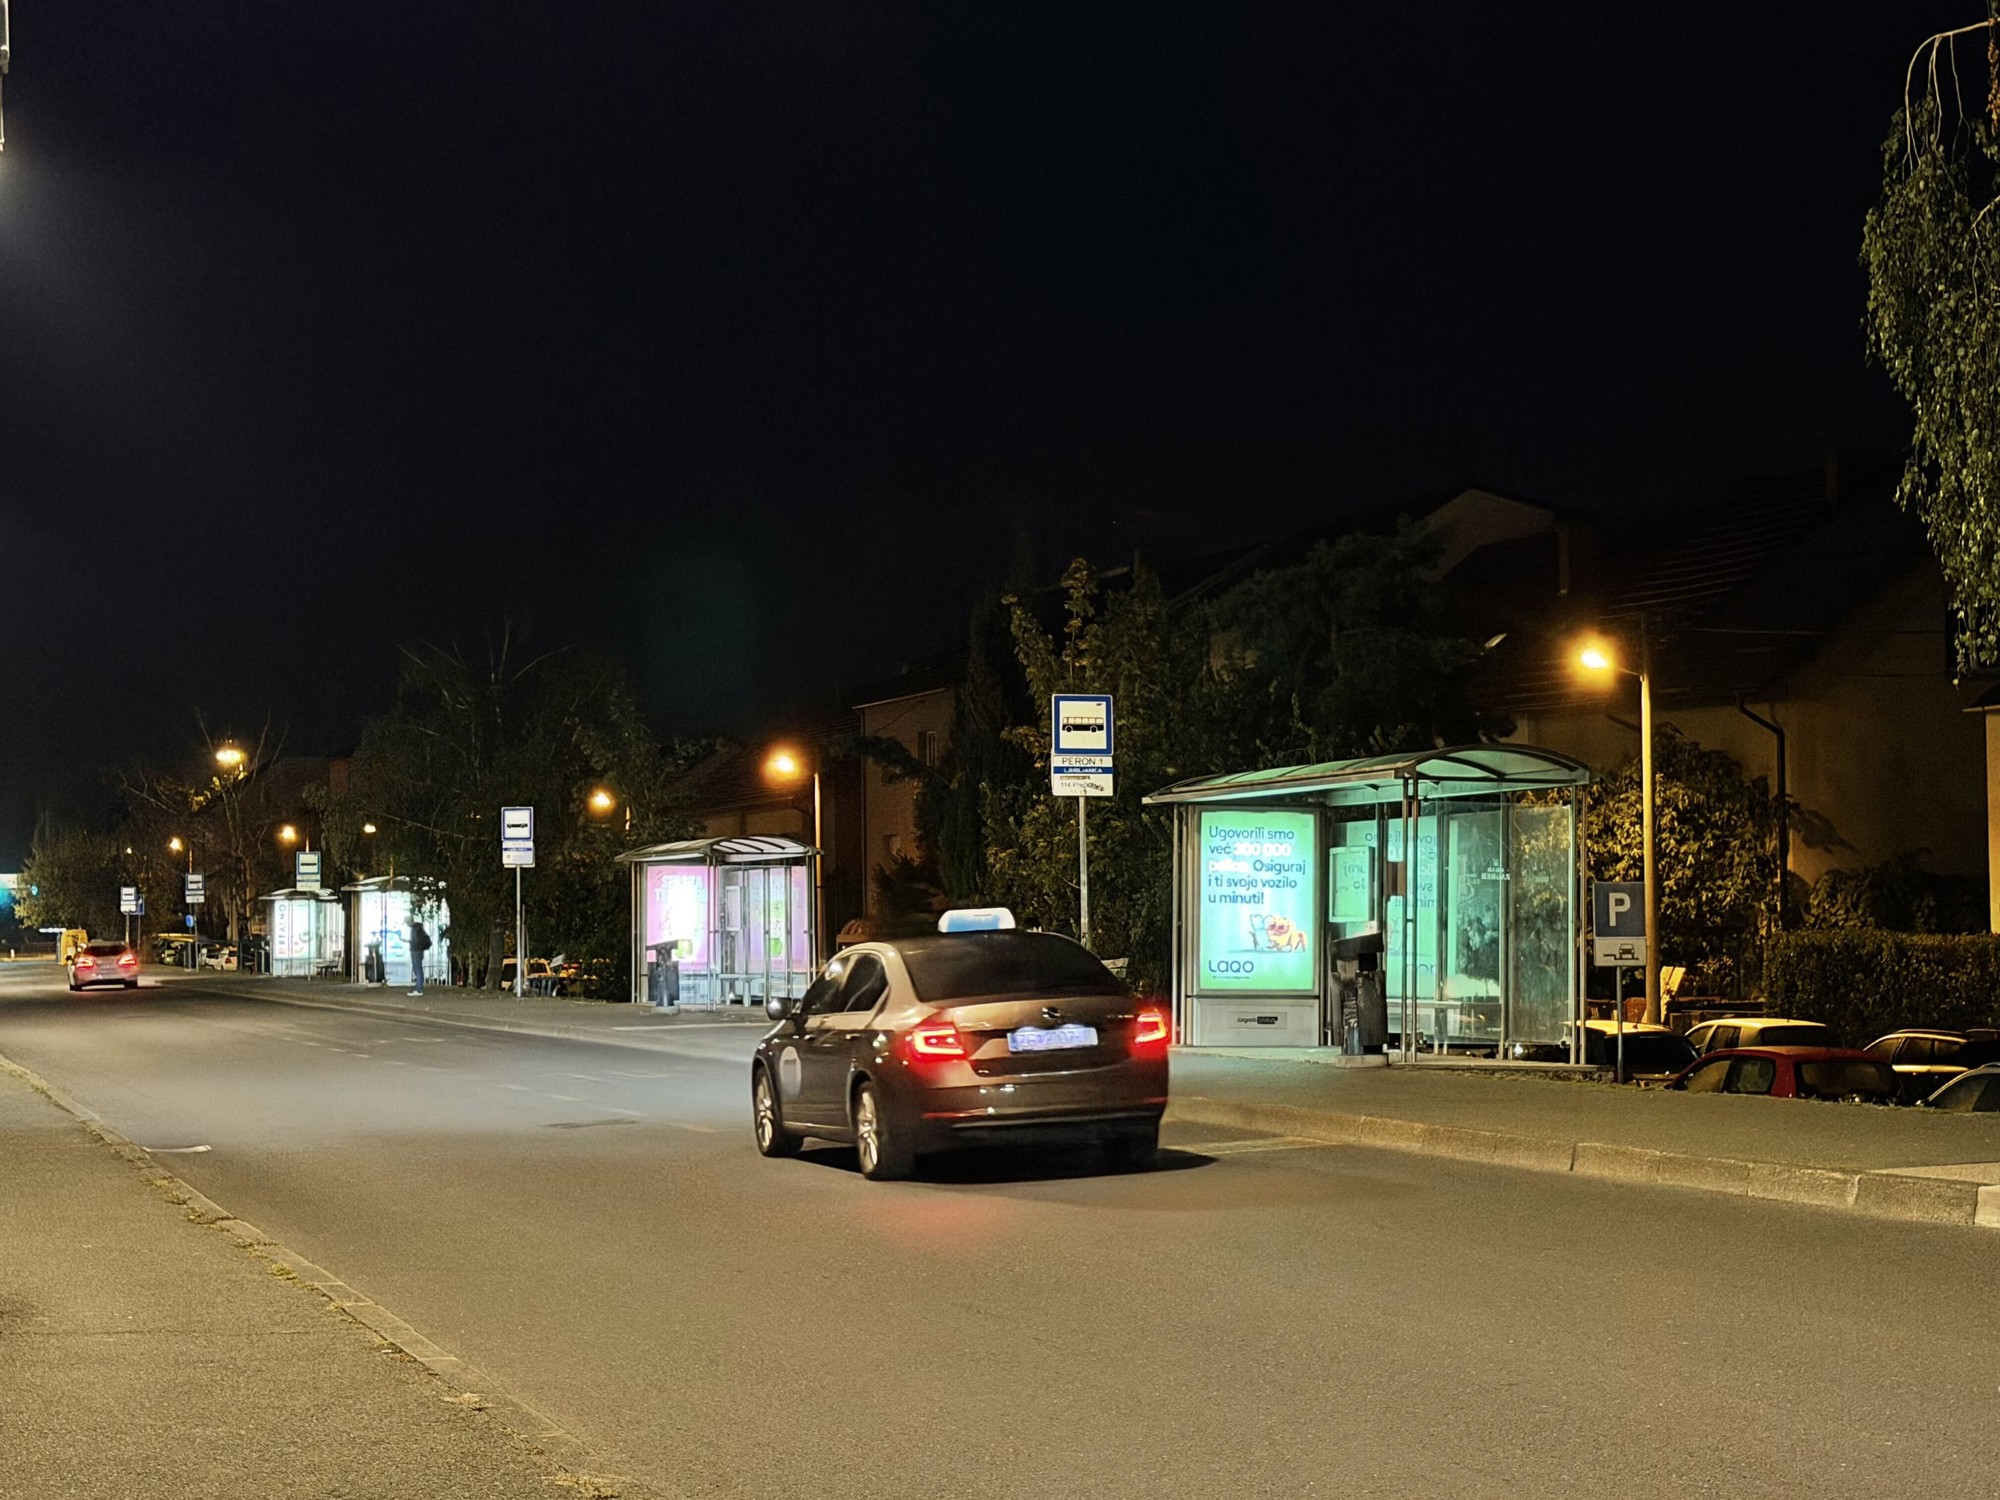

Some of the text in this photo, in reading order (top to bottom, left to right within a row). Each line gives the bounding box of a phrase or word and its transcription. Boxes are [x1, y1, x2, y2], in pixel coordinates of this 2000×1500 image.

[1062, 757, 1095, 765] PERON
[1209, 825, 1295, 841] Ugovorili smo
[1209, 842, 1232, 854] već
[1253, 859, 1306, 876] Osiguraj
[1208, 874, 1298, 891] i ti svoje vozilo
[1208, 891, 1264, 904] u minuti!
[1609, 892, 1631, 927] P
